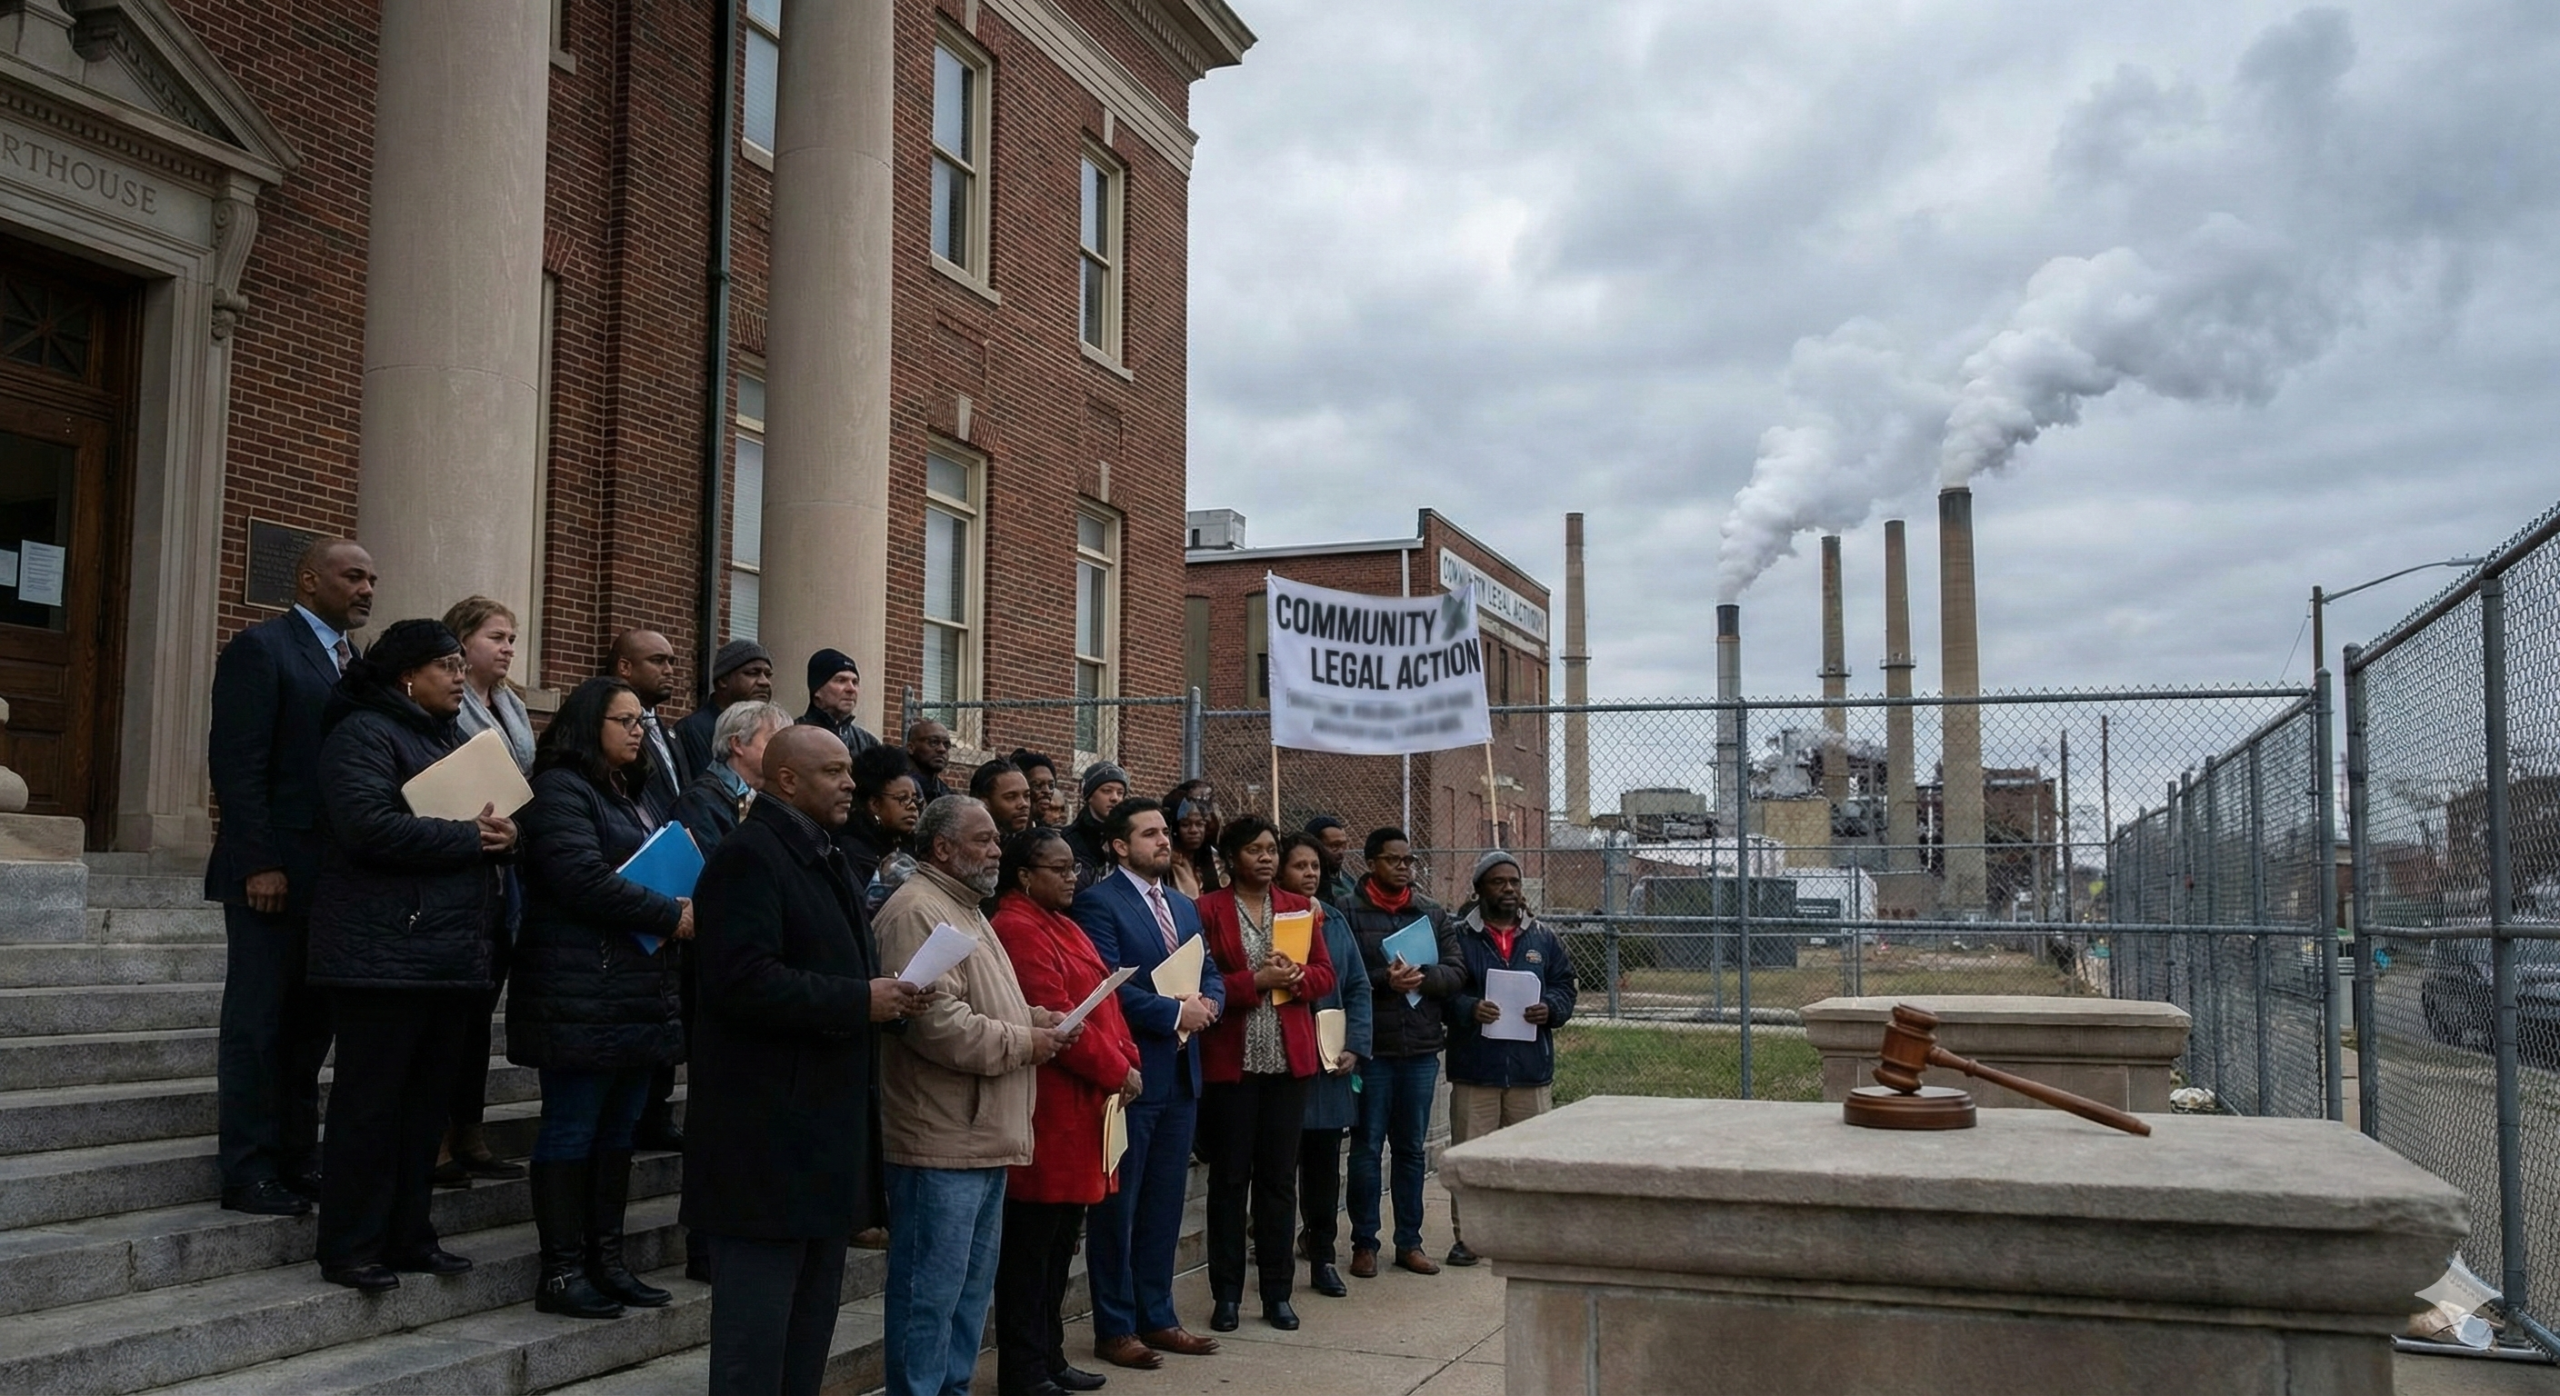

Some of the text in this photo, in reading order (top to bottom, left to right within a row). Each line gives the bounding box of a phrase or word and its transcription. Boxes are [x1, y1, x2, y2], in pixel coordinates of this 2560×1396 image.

[1, 132, 157, 215] RTHOUSE
[1276, 593, 1437, 647] COMMUNITY
[1311, 638, 1481, 690] LEGAL ACTION
